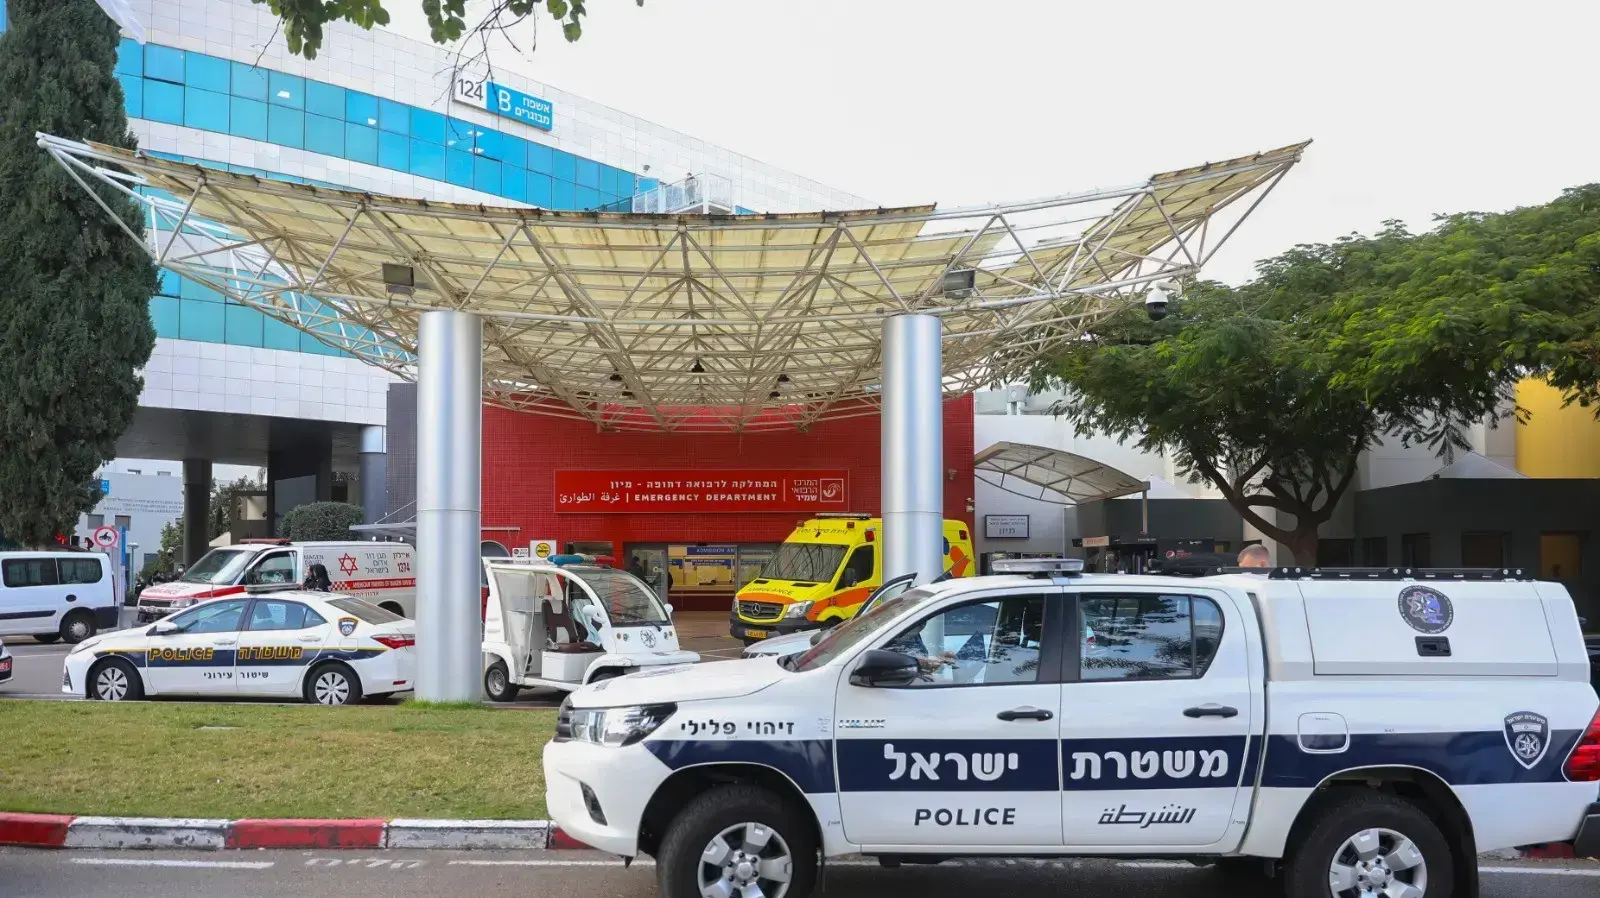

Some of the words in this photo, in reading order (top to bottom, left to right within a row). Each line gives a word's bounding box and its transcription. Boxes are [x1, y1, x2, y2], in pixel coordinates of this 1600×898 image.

[457, 78, 483, 101] 124
[498, 89, 512, 112] B
[514, 106, 550, 125] מבוגרים
[610, 481, 633, 490] מיון
[647, 481, 681, 489] דחופה
[686, 480, 727, 489] לרפואה
[731, 480, 777, 489] המחלקה
[600, 492, 621, 504] غرفة
[634, 493, 700, 501] EMERGENCY
[705, 493, 778, 501] DEPARTMENT
[795, 494, 818, 502] שמיר
[148, 646, 214, 661] POLICE
[237, 645, 304, 660] משטרה
[203, 671, 233, 679] עירוני
[240, 671, 269, 679] שיטור
[681, 718, 737, 736] פלילי
[747, 721, 795, 735] זיהוי
[837, 719, 886, 728] HILUX
[884, 743, 1019, 781] ישראל
[1070, 749, 1229, 780] משטרת
[914, 807, 1016, 826] POLICE
[1097, 804, 1197, 829] الشرطة
